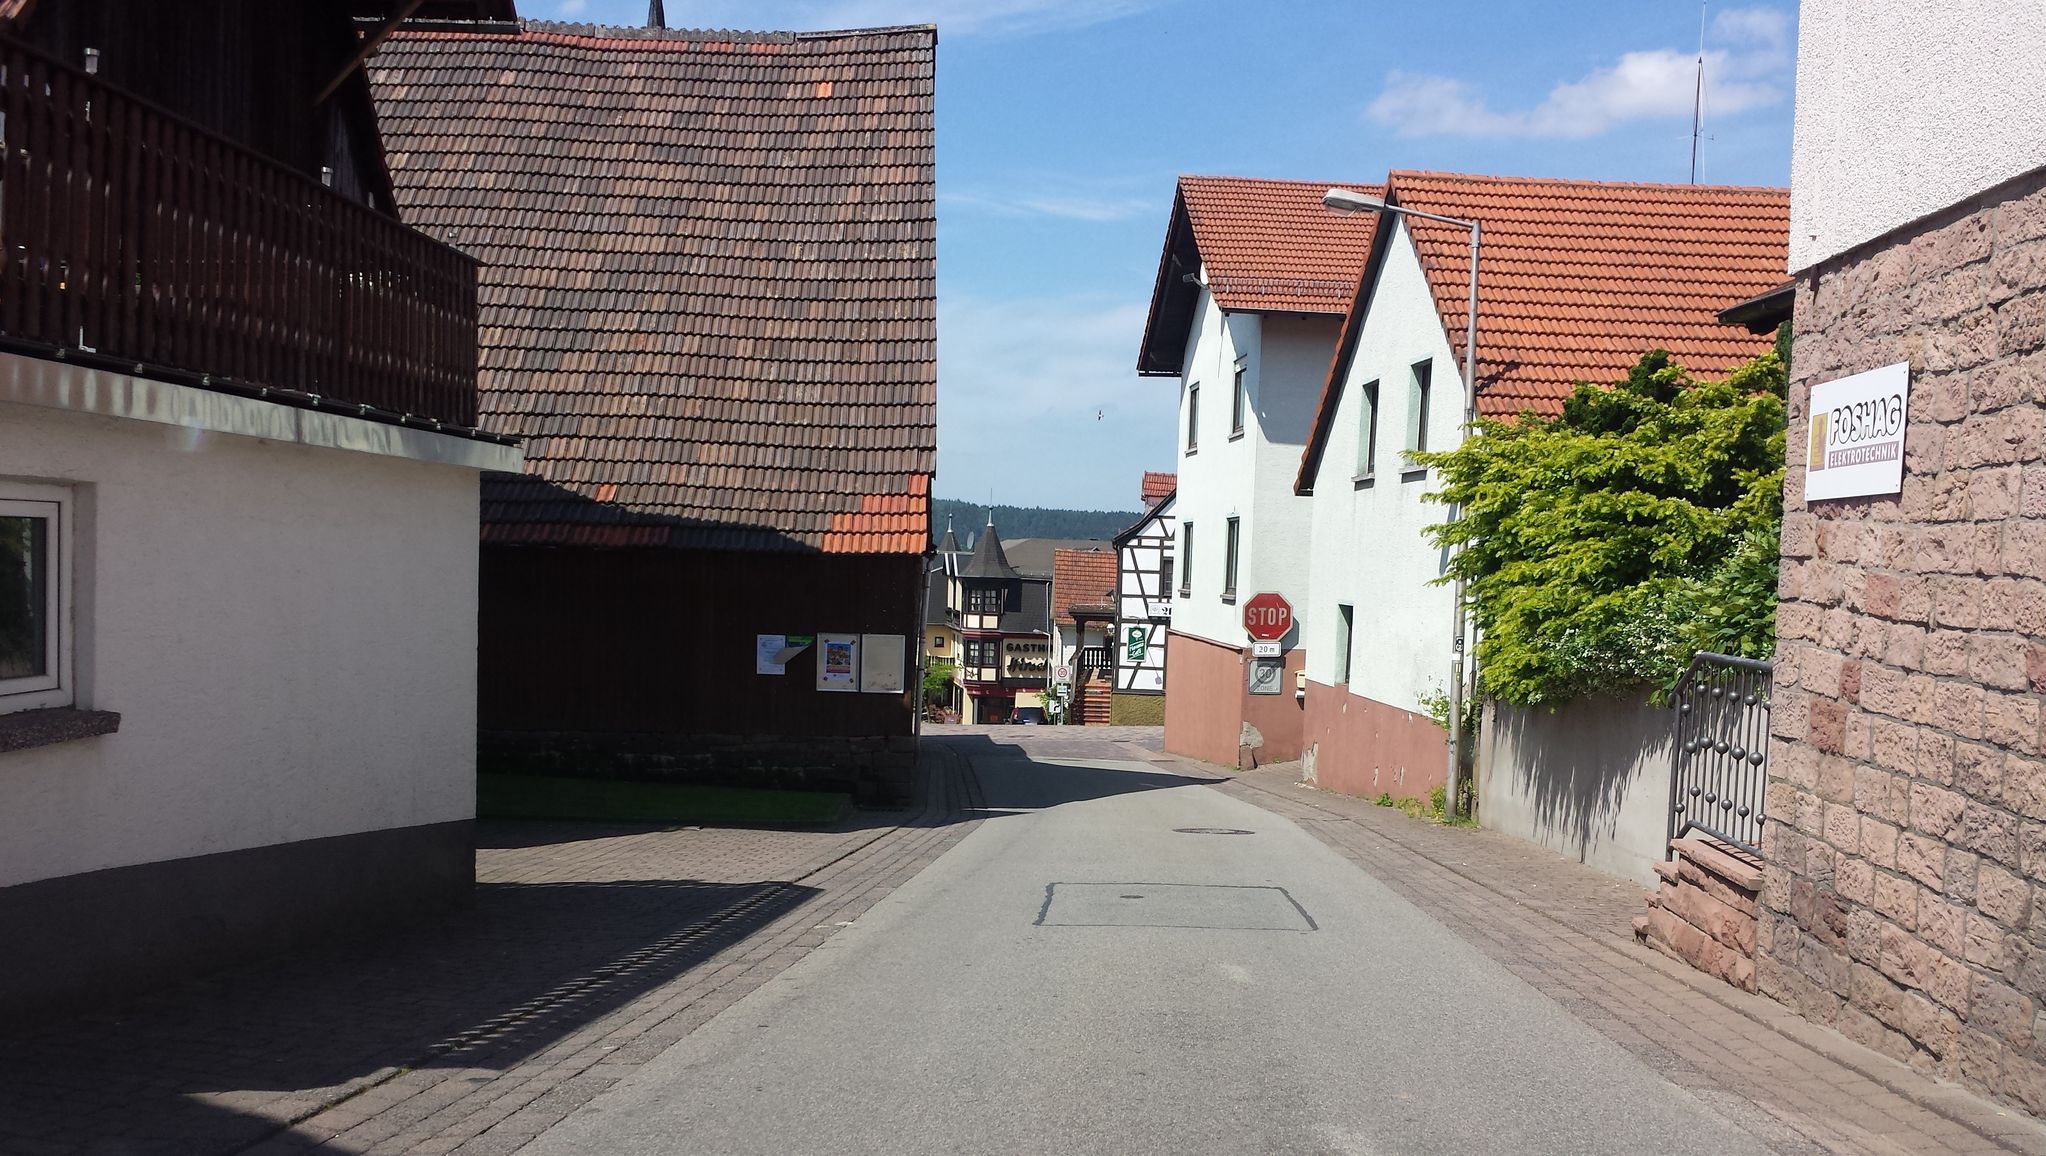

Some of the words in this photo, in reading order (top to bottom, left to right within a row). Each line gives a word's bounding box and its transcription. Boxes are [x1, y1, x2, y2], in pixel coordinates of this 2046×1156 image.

[1829, 394, 1902, 446] FOSHAG
[1830, 443, 1897, 467] ELEKTROTECHNIK
[1248, 607, 1287, 626] STOP
[1259, 645, 1268, 653] 20
[1259, 668, 1272, 678] 30
